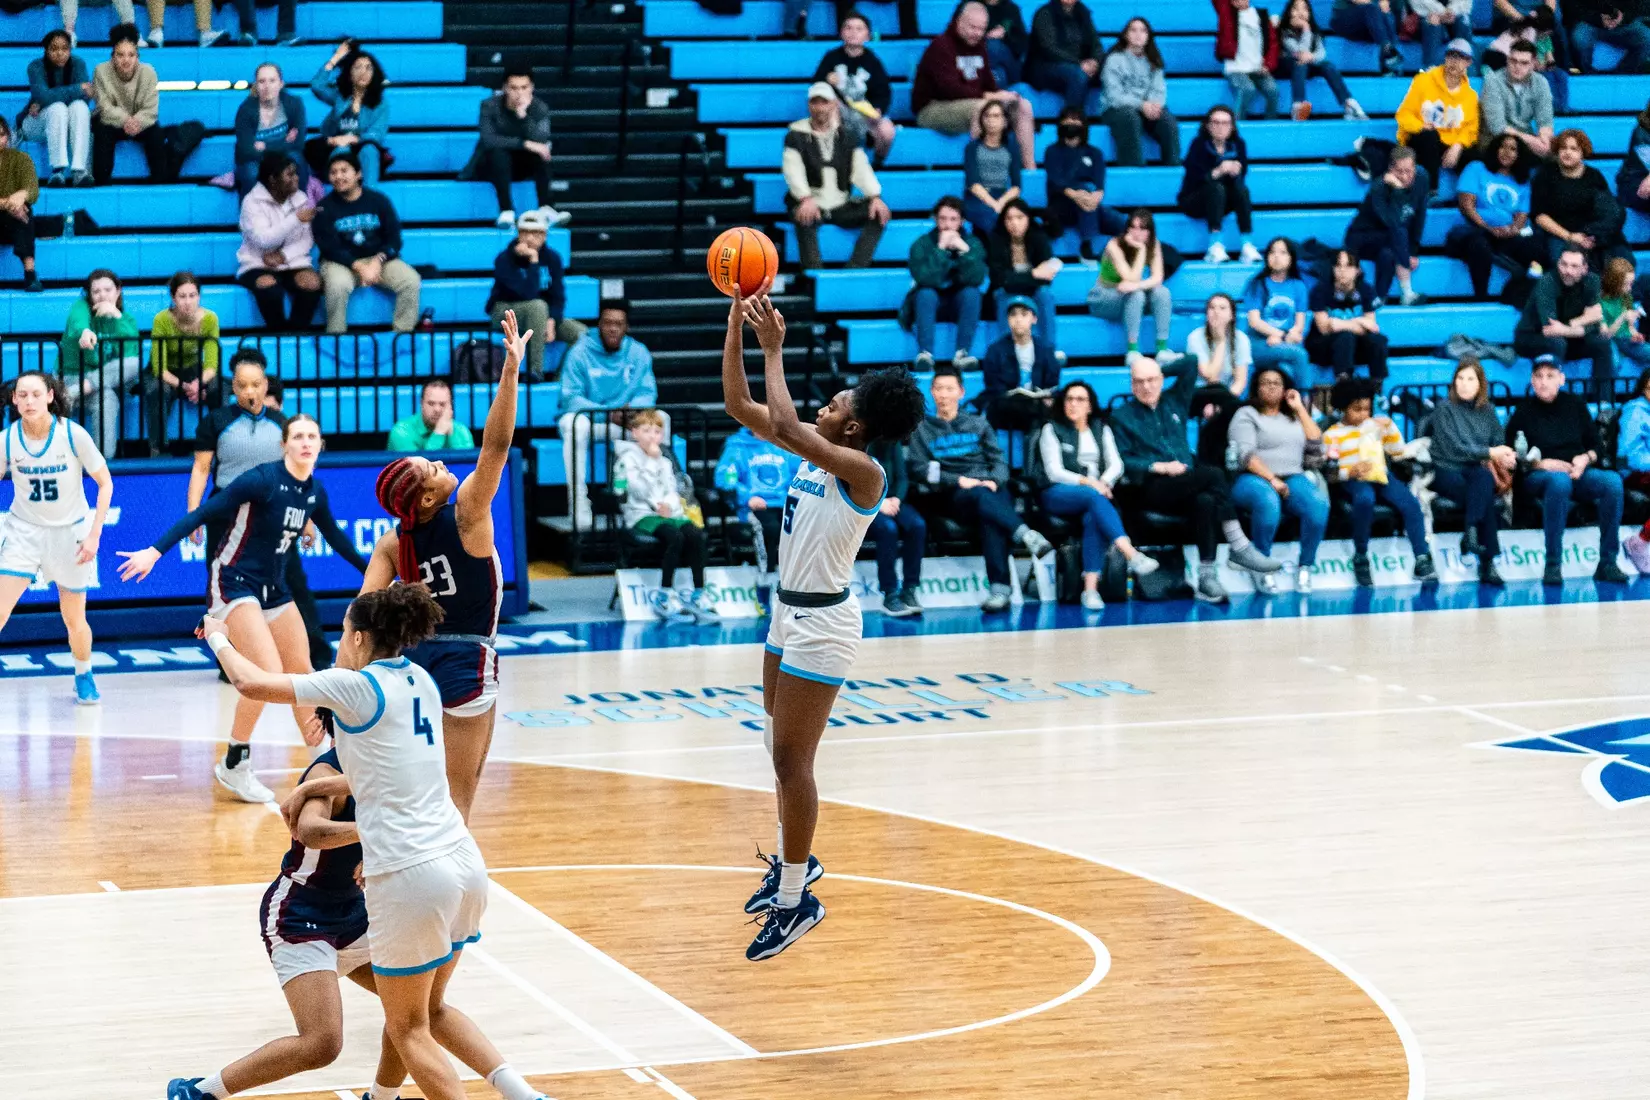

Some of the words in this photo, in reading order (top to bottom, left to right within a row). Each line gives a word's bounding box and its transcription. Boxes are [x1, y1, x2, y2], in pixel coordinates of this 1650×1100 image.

[720, 247, 732, 286] ELITE
[28, 478, 59, 502] 35
[283, 506, 306, 529] FDU
[783, 495, 800, 535] 5
[503, 680, 1156, 727] SCHLLER
[563, 676, 942, 704] JONATAN
[413, 696, 435, 746] 4
[740, 707, 991, 731] CURT
